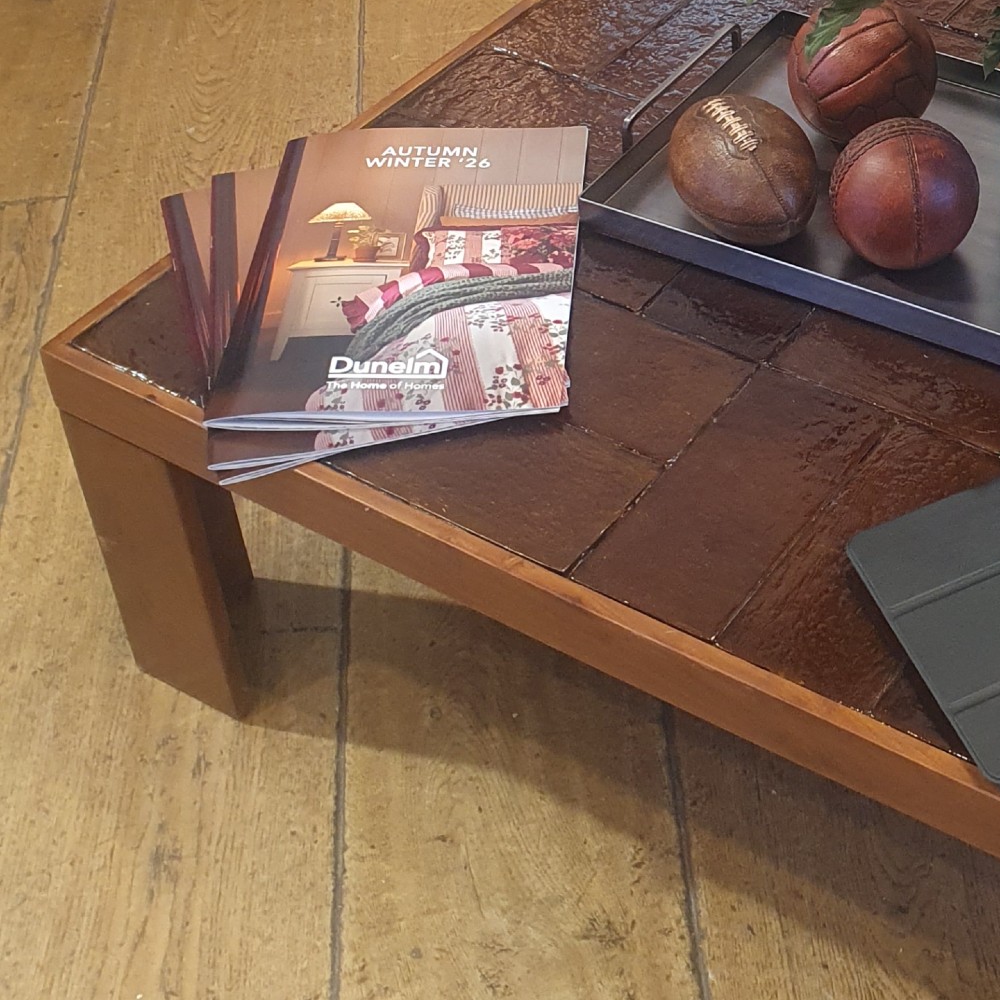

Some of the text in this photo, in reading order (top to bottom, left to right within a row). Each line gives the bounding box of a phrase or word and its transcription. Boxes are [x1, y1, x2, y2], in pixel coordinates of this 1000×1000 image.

[381, 145, 478, 157] AUTUMN
[365, 157, 491, 168] WINTER '26
[328, 352, 445, 377] Dunelm
[326, 381, 444, 391] The Home of Homes
